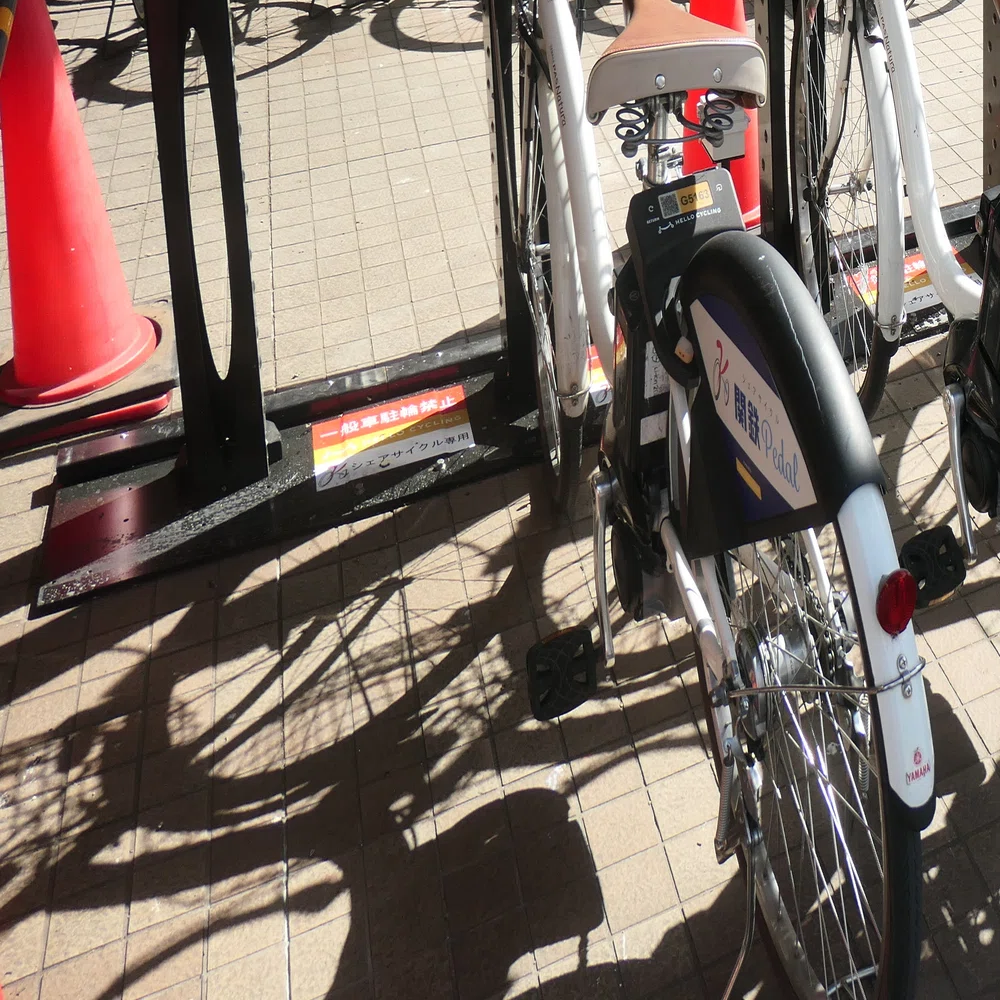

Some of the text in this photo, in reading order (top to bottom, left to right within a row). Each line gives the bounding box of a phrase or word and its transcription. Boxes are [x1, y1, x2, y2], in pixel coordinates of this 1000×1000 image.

[884, 36, 896, 74] Natura
[555, 85, 567, 127] Natura
[680, 189, 710, 206] G5163
[675, 207, 722, 226] HELLO CYCLING
[904, 278, 927, 289] ELLO
[320, 395, 458, 439] 一般車駐輪禁止
[409, 414, 463, 432] CYCLING
[351, 431, 470, 470] シェアサイクル専用
[733, 382, 800, 493] 関鉄 Pedal
[906, 763, 931, 783] YAMAHA
